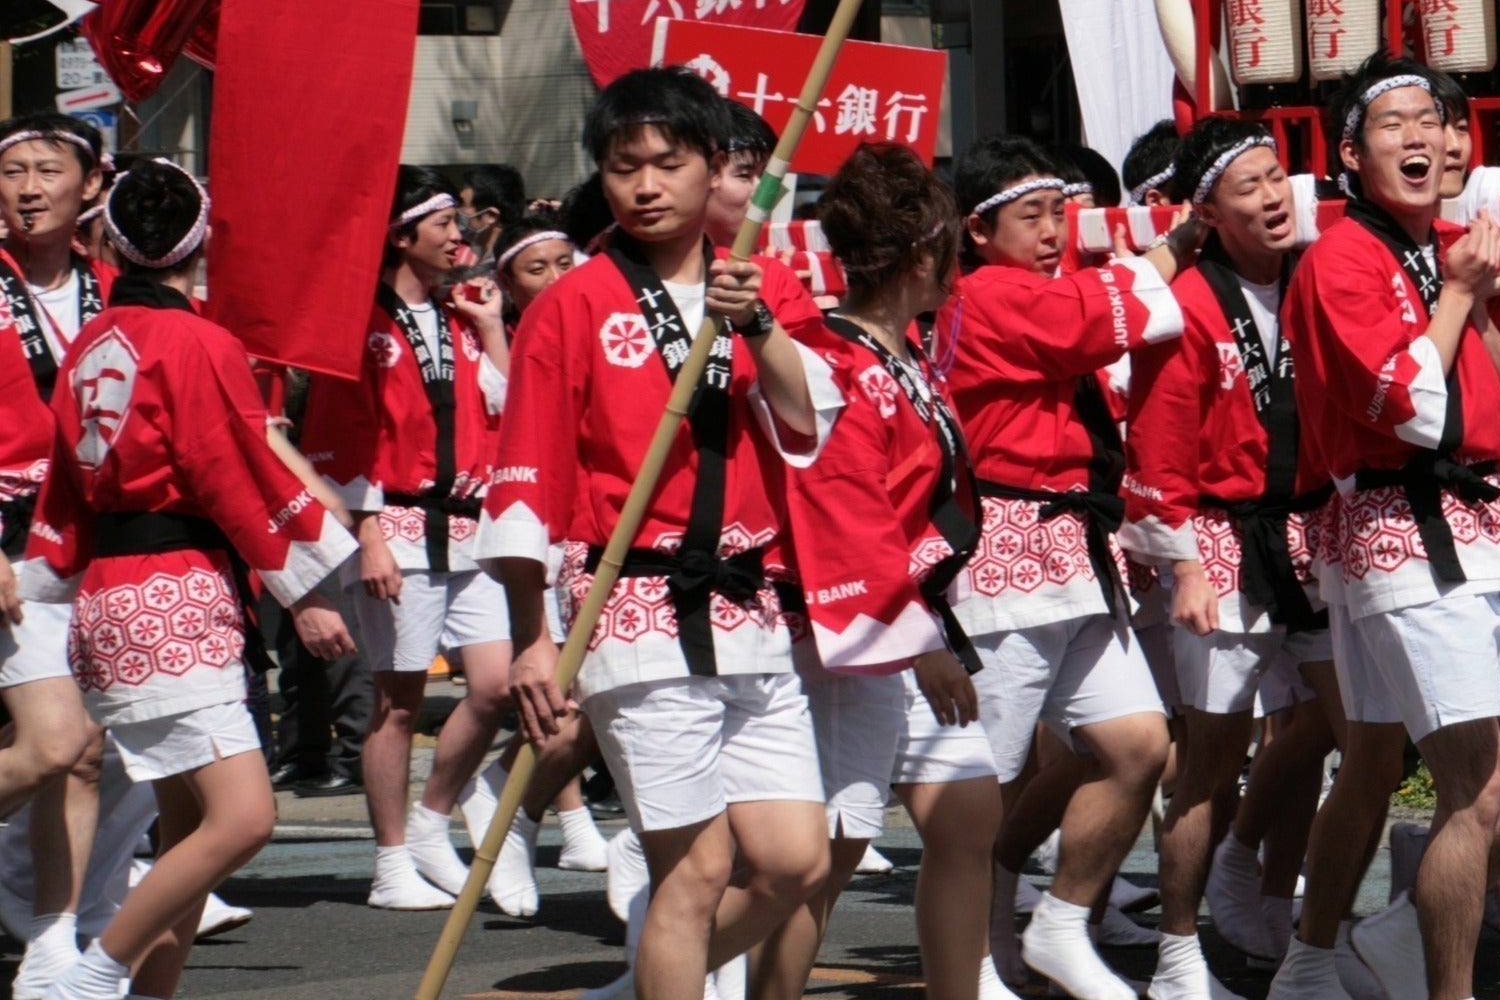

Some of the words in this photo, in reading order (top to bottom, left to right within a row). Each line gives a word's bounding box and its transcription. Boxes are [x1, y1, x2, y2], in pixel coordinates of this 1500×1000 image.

[1106, 285, 1129, 349] JUROKU
[1230, 317, 1271, 412] 十六銀行
[494, 465, 538, 484] BANK
[818, 579, 868, 605] BANK
